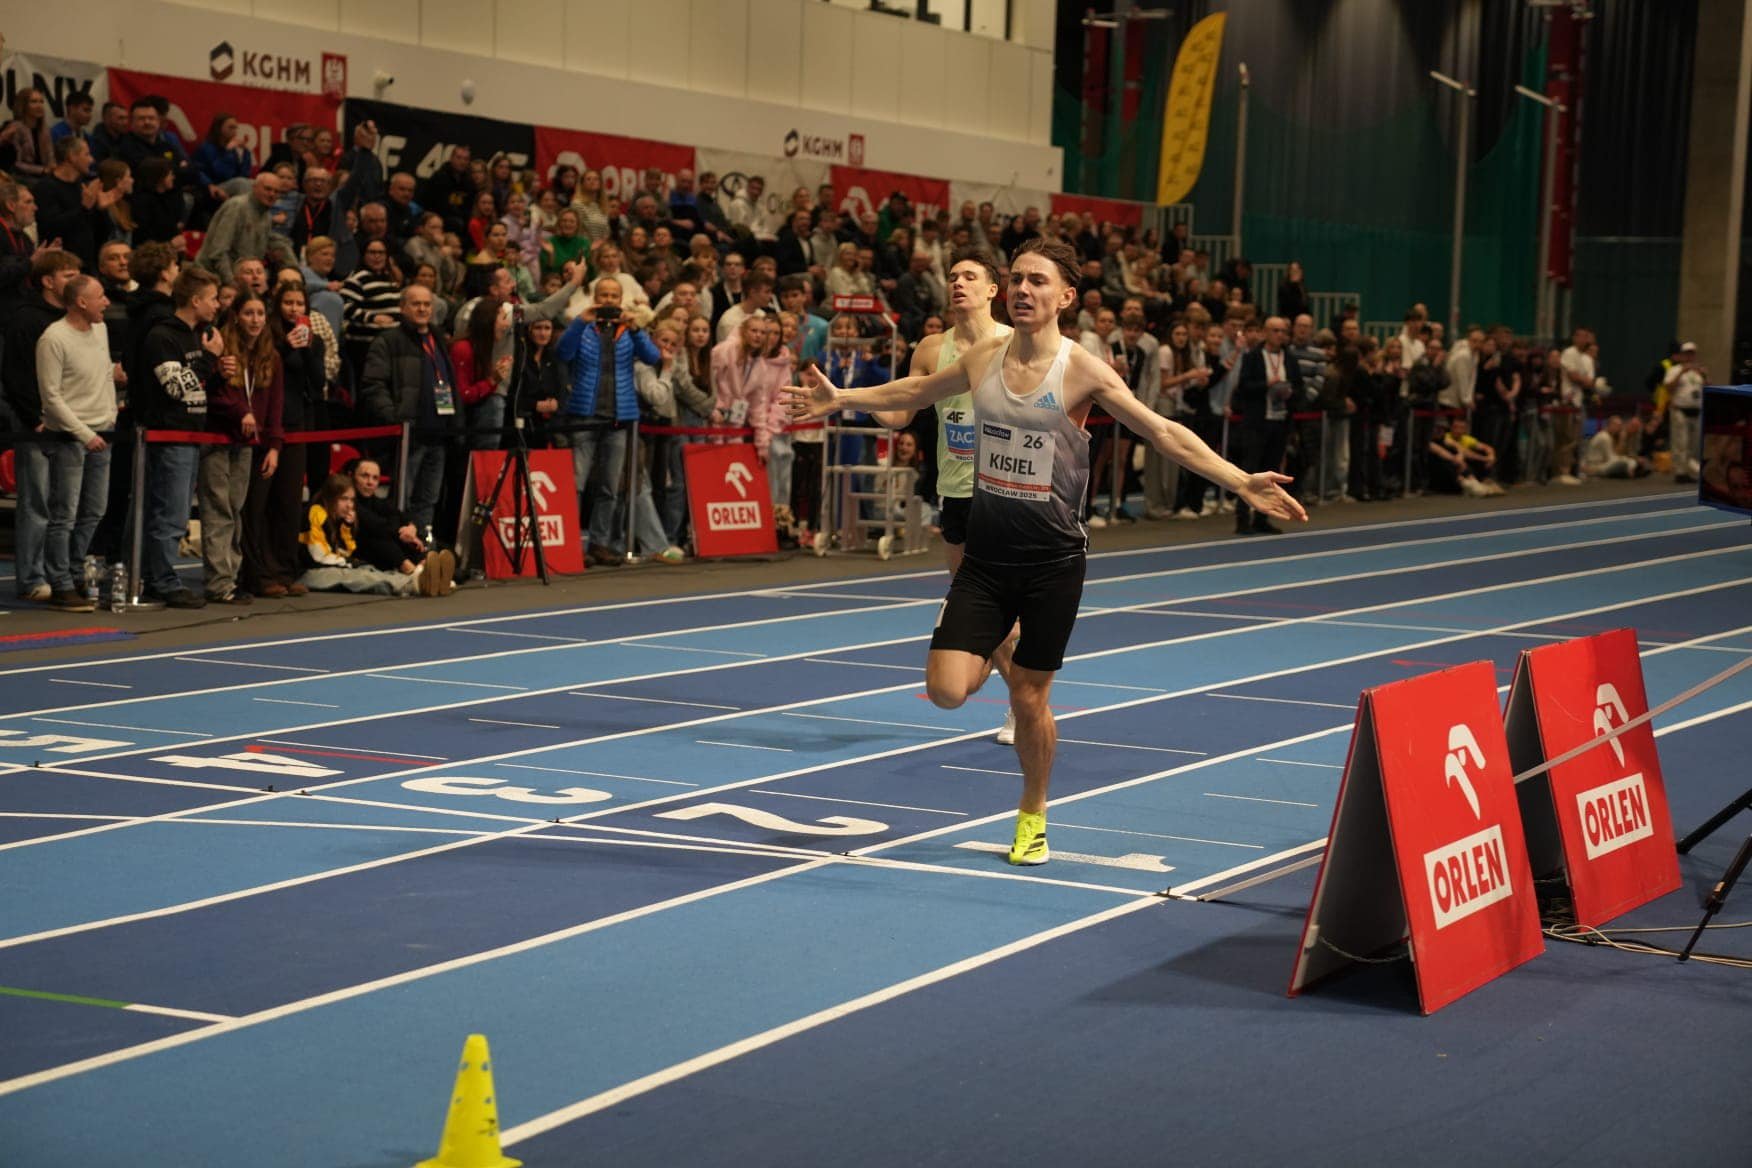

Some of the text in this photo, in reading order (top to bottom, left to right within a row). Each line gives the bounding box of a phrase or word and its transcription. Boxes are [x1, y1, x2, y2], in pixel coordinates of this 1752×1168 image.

[242, 51, 311, 85] KGHM
[802, 135, 843, 158] KGHM
[949, 429, 975, 444] ZAC
[1023, 434, 1044, 450] 26
[989, 452, 1037, 476] KISIEL
[711, 505, 757, 525] ORLEN
[400, 776, 614, 805] 3
[652, 802, 890, 836] 2
[1584, 784, 1647, 847] ORLEN
[1433, 838, 1506, 914] ORLEN
